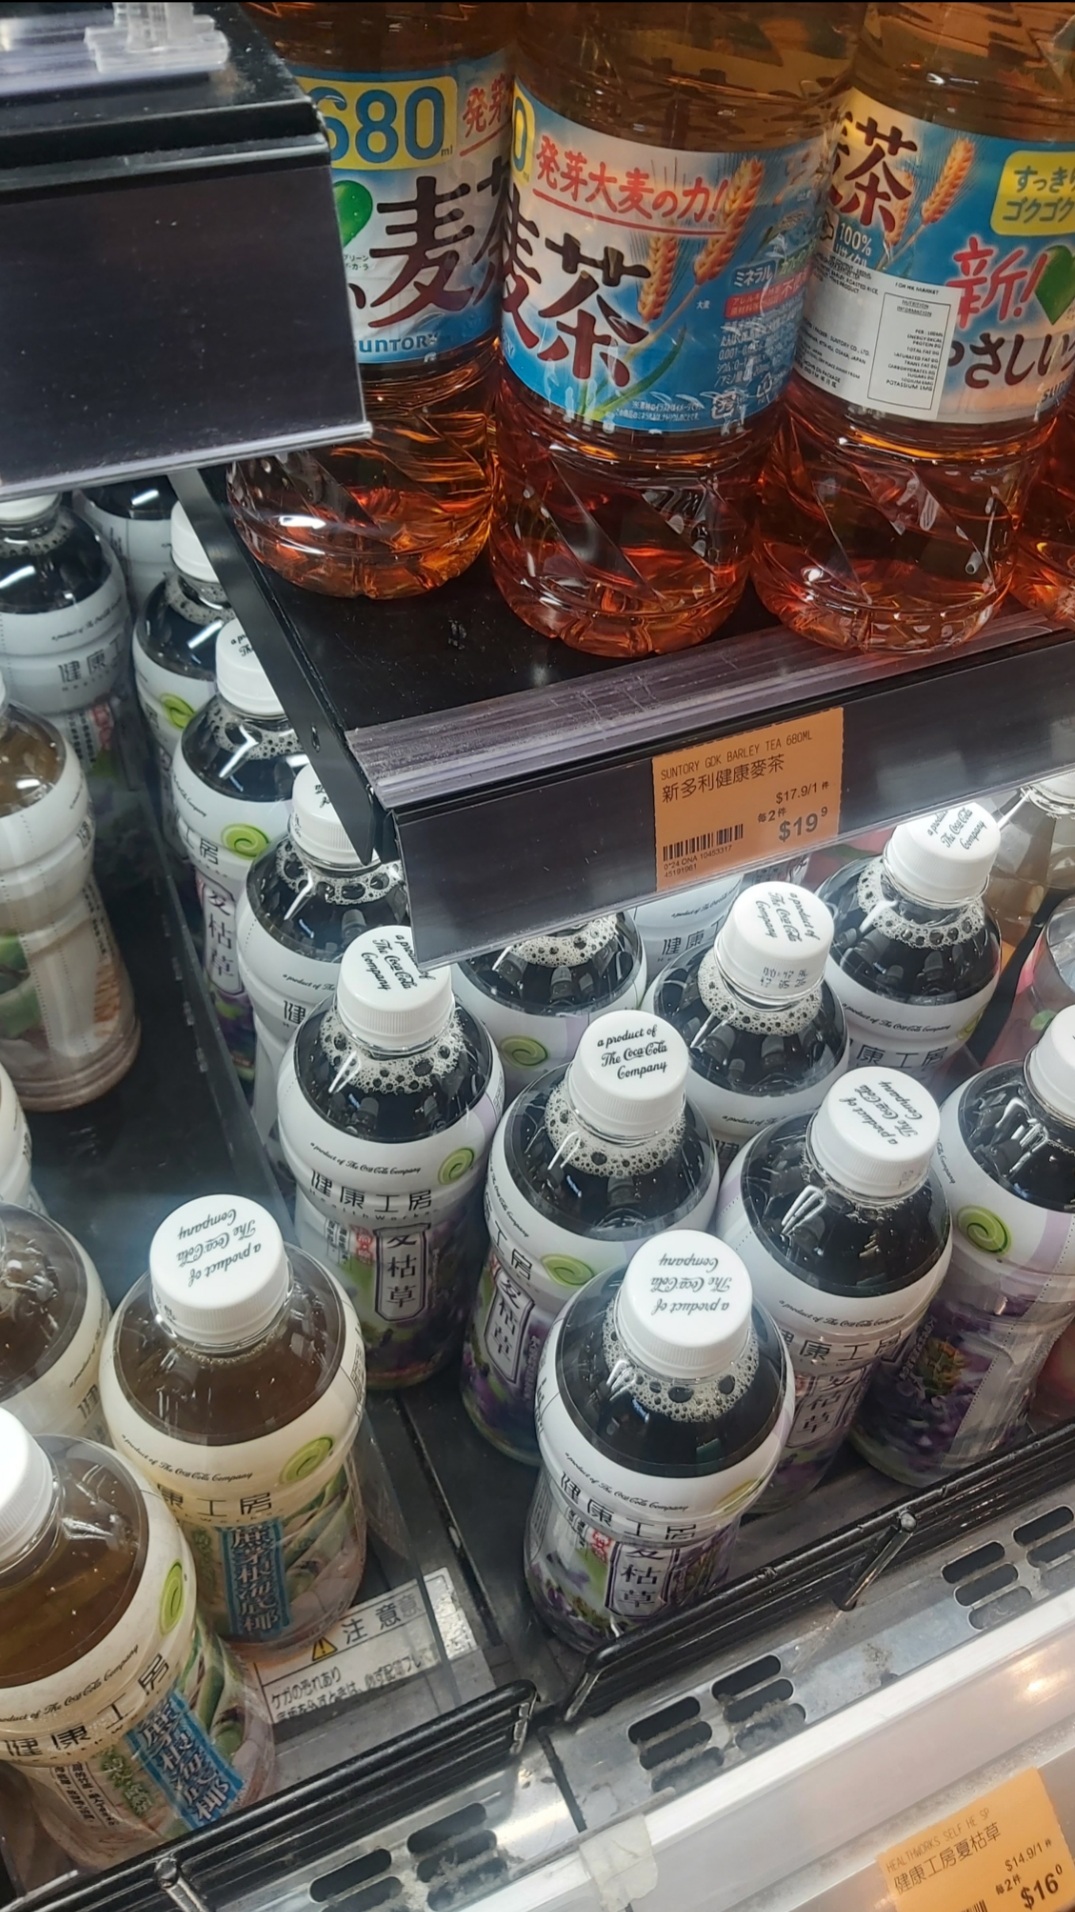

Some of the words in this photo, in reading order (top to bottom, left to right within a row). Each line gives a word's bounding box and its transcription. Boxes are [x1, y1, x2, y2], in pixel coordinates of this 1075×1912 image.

[308, 86, 444, 163] 680
[536, 135, 728, 221] 発芽大麦の力!
[839, 222, 872, 257] 100%
[734, 265, 772, 288] ミネラル
[661, 760, 700, 781] SUNTORY
[726, 744, 760, 763] BARLEY
[765, 738, 781, 751] TEA
[786, 730, 812, 747] 680ML
[662, 754, 785, 803] 新多利健康麥茶
[775, 782, 818, 804] $17.9/1
[822, 780, 829, 790] 件
[757, 807, 787, 824] 每2件
[940, 832, 956, 848] The
[960, 820, 987, 850] Company
[755, 900, 777, 938] Company
[788, 897, 814, 929] product
[804, 929, 820, 940] of
[372, 938, 393, 954] The
[288, 975, 312, 989] product
[313, 982, 320, 990] of
[361, 951, 392, 991] Company
[597, 1038, 604, 1047] a
[605, 1028, 644, 1048] product
[647, 1024, 658, 1038] of
[601, 1051, 622, 1067] The
[617, 1060, 667, 1080] Company
[839, 1097, 857, 1106] of
[878, 1081, 922, 1120] Company
[729, 1116, 754, 1125] product
[754, 1116, 764, 1126] of
[852, 1107, 896, 1137] product
[894, 1120, 918, 1137] The
[313, 1145, 337, 1162] product
[337, 1157, 345, 1166] of
[346, 1160, 359, 1170] The
[390, 1166, 421, 1176] Company
[311, 1168, 432, 1213] 健康工房
[177, 1209, 237, 1240] Company
[233, 1219, 256, 1241] The
[208, 1248, 252, 1272] product
[254, 1243, 262, 1254] a
[658, 1253, 719, 1273] Company
[188, 1269, 202, 1287] of
[708, 1277, 733, 1292] The
[652, 1298, 668, 1316] of
[670, 1297, 717, 1314] product
[721, 1302, 730, 1311] a
[783, 1302, 813, 1319] product
[812, 1313, 821, 1323] of
[822, 1315, 838, 1326] The
[124, 1438, 149, 1459] product
[149, 1457, 158, 1466] of
[159, 1461, 173, 1473] The
[212, 1471, 253, 1482] Company
[568, 1456, 590, 1479] product
[590, 1476, 598, 1485] of
[598, 1482, 614, 1495] The
[649, 1501, 689, 1512] Company
[561, 1473, 696, 1540] 健康工房
[341, 1602, 402, 1645] 注意
[30, 1709, 42, 1719] of
[44, 1703, 62, 1714] The
[103, 1644, 139, 1682] Company
[270, 1666, 342, 1710] ケガの恐れあり
[3, 1653, 170, 1757] 健康工房
[887, 1836, 941, 1873] HEALTHWORKS
[943, 1824, 962, 1842] SELF
[966, 1816, 977, 1830] HE
[979, 1807, 990, 1821] SP
[894, 1822, 1001, 1894] 健康工房夏枯草
[1004, 1842, 1043, 1872] $14.9/1
